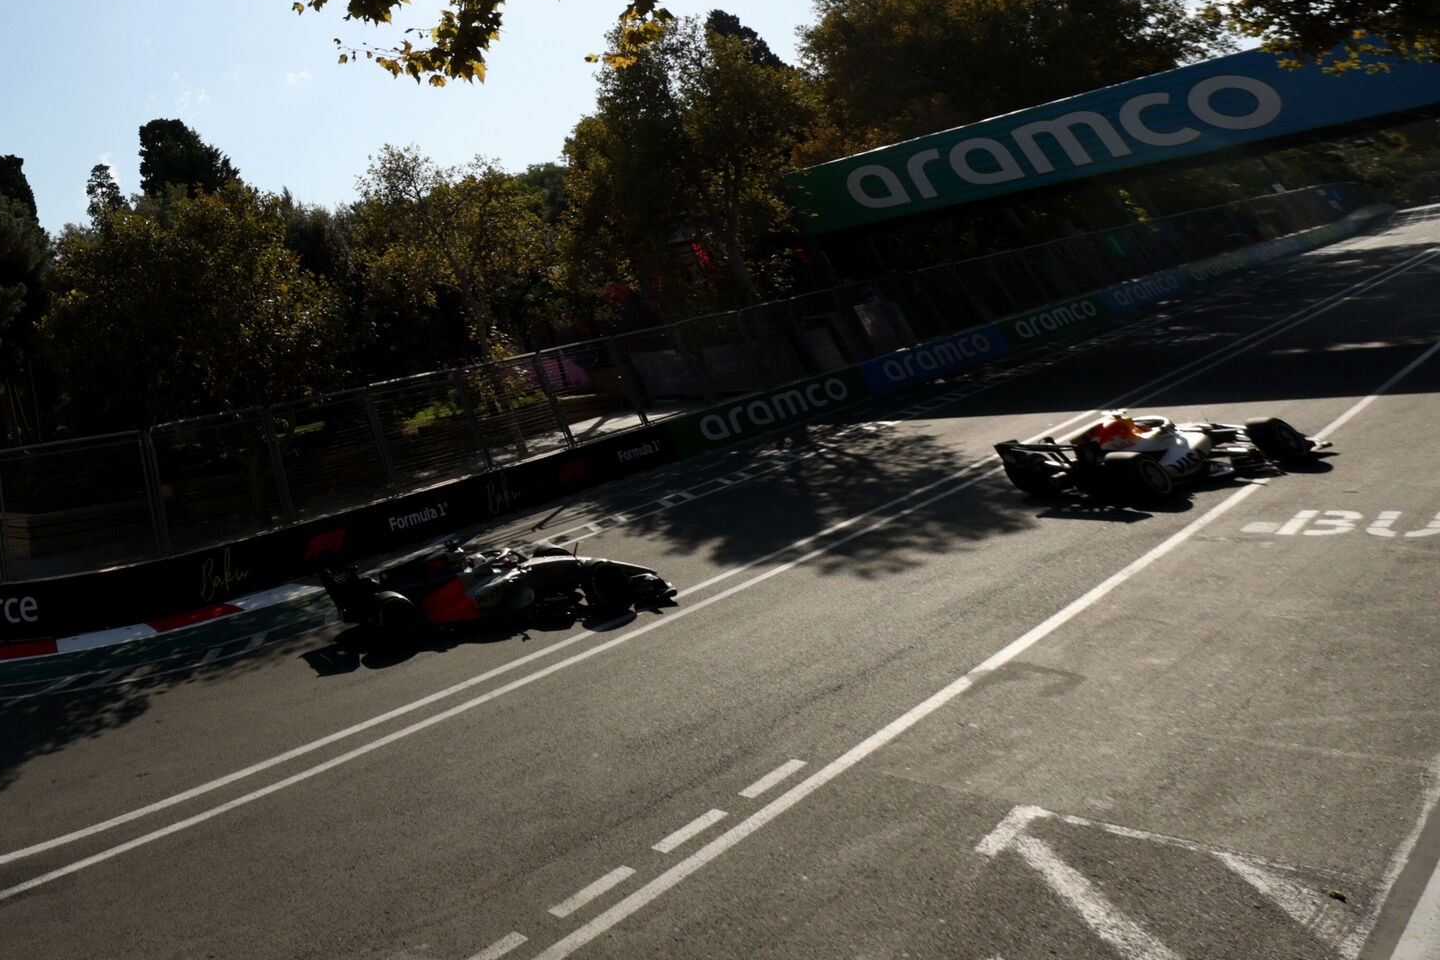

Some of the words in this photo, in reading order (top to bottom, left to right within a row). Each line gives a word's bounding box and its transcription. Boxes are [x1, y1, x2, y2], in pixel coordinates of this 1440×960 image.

[846, 75, 1282, 209] aramco
[1113, 272, 1178, 306] aramco
[1190, 254, 1244, 282] aramco
[1013, 297, 1097, 339] aramco
[882, 333, 991, 383] aramco
[699, 377, 848, 444] aramco
[616, 442, 653, 464] Formula
[487, 471, 522, 515] Baku
[388, 506, 439, 532] Formula
[199, 546, 249, 602] Baku
